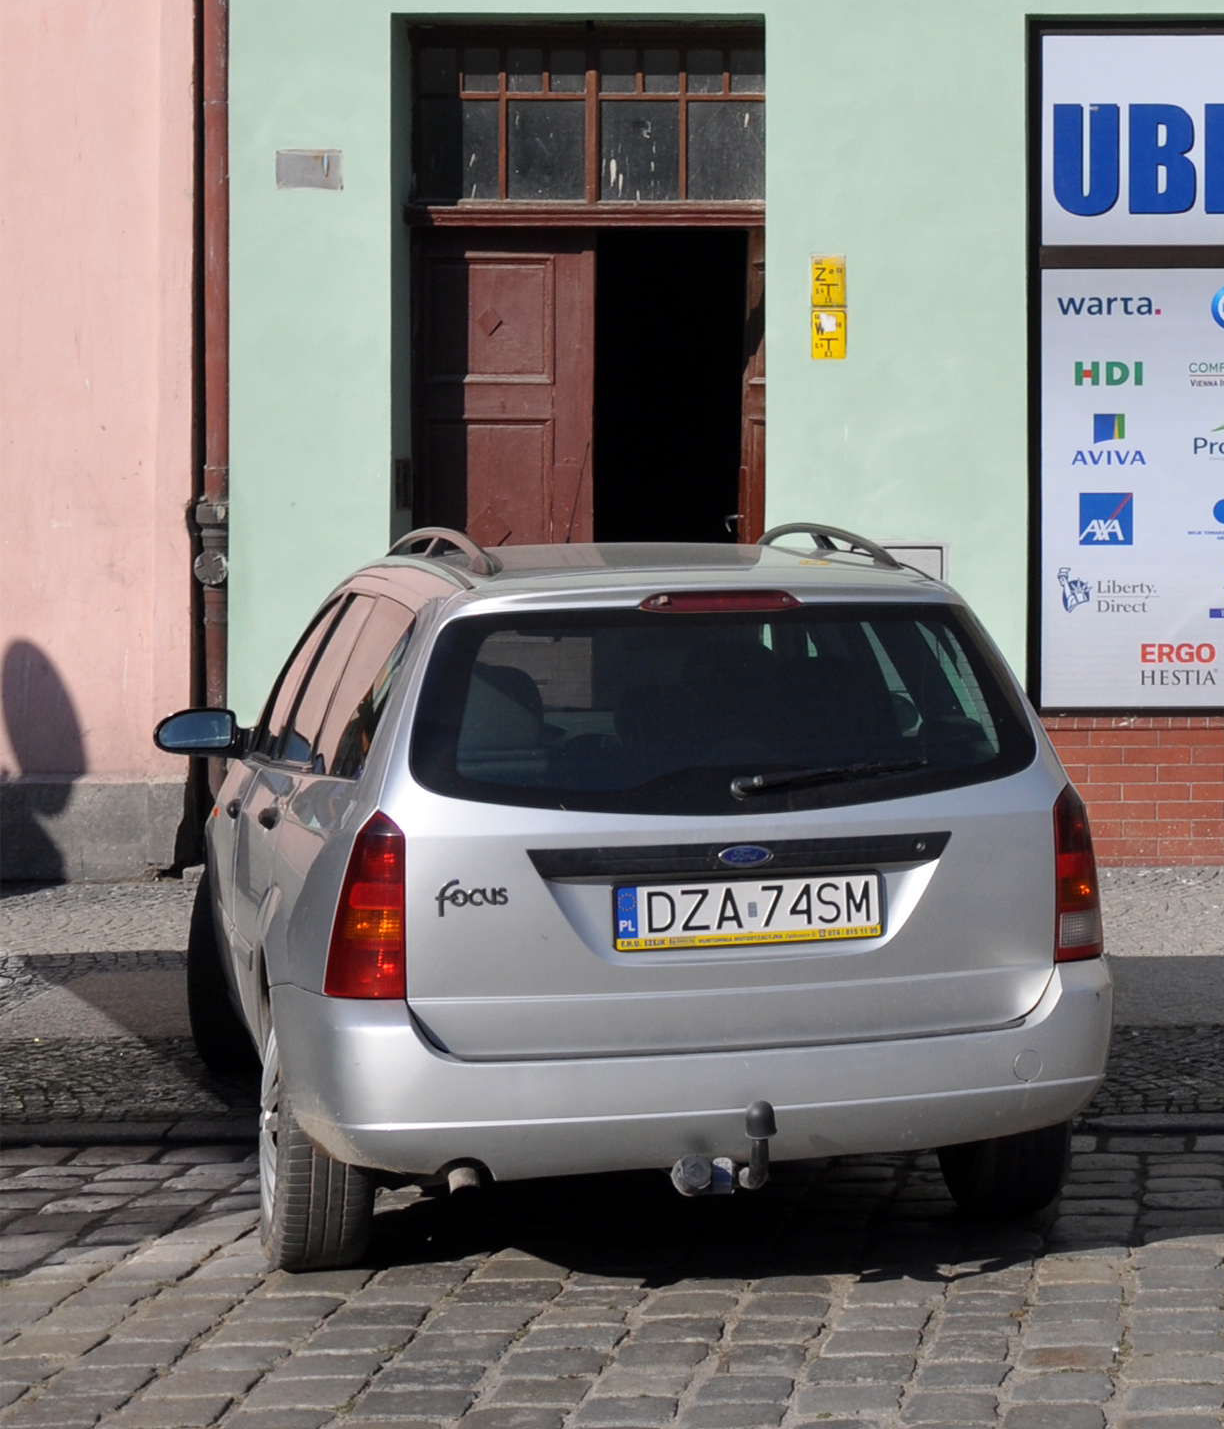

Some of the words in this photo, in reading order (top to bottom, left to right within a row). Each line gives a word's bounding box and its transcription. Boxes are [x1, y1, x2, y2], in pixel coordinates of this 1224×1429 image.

[1075, 361, 1143, 386] HDI
[1072, 451, 1146, 465] AVIVA
[1080, 519, 1124, 541] AXA
[1097, 600, 1147, 613] Direct
[1141, 643, 1215, 663] ERGO
[647, 887, 743, 933] DZA
[761, 880, 871, 927] 74SM
[619, 921, 635, 932] PL
